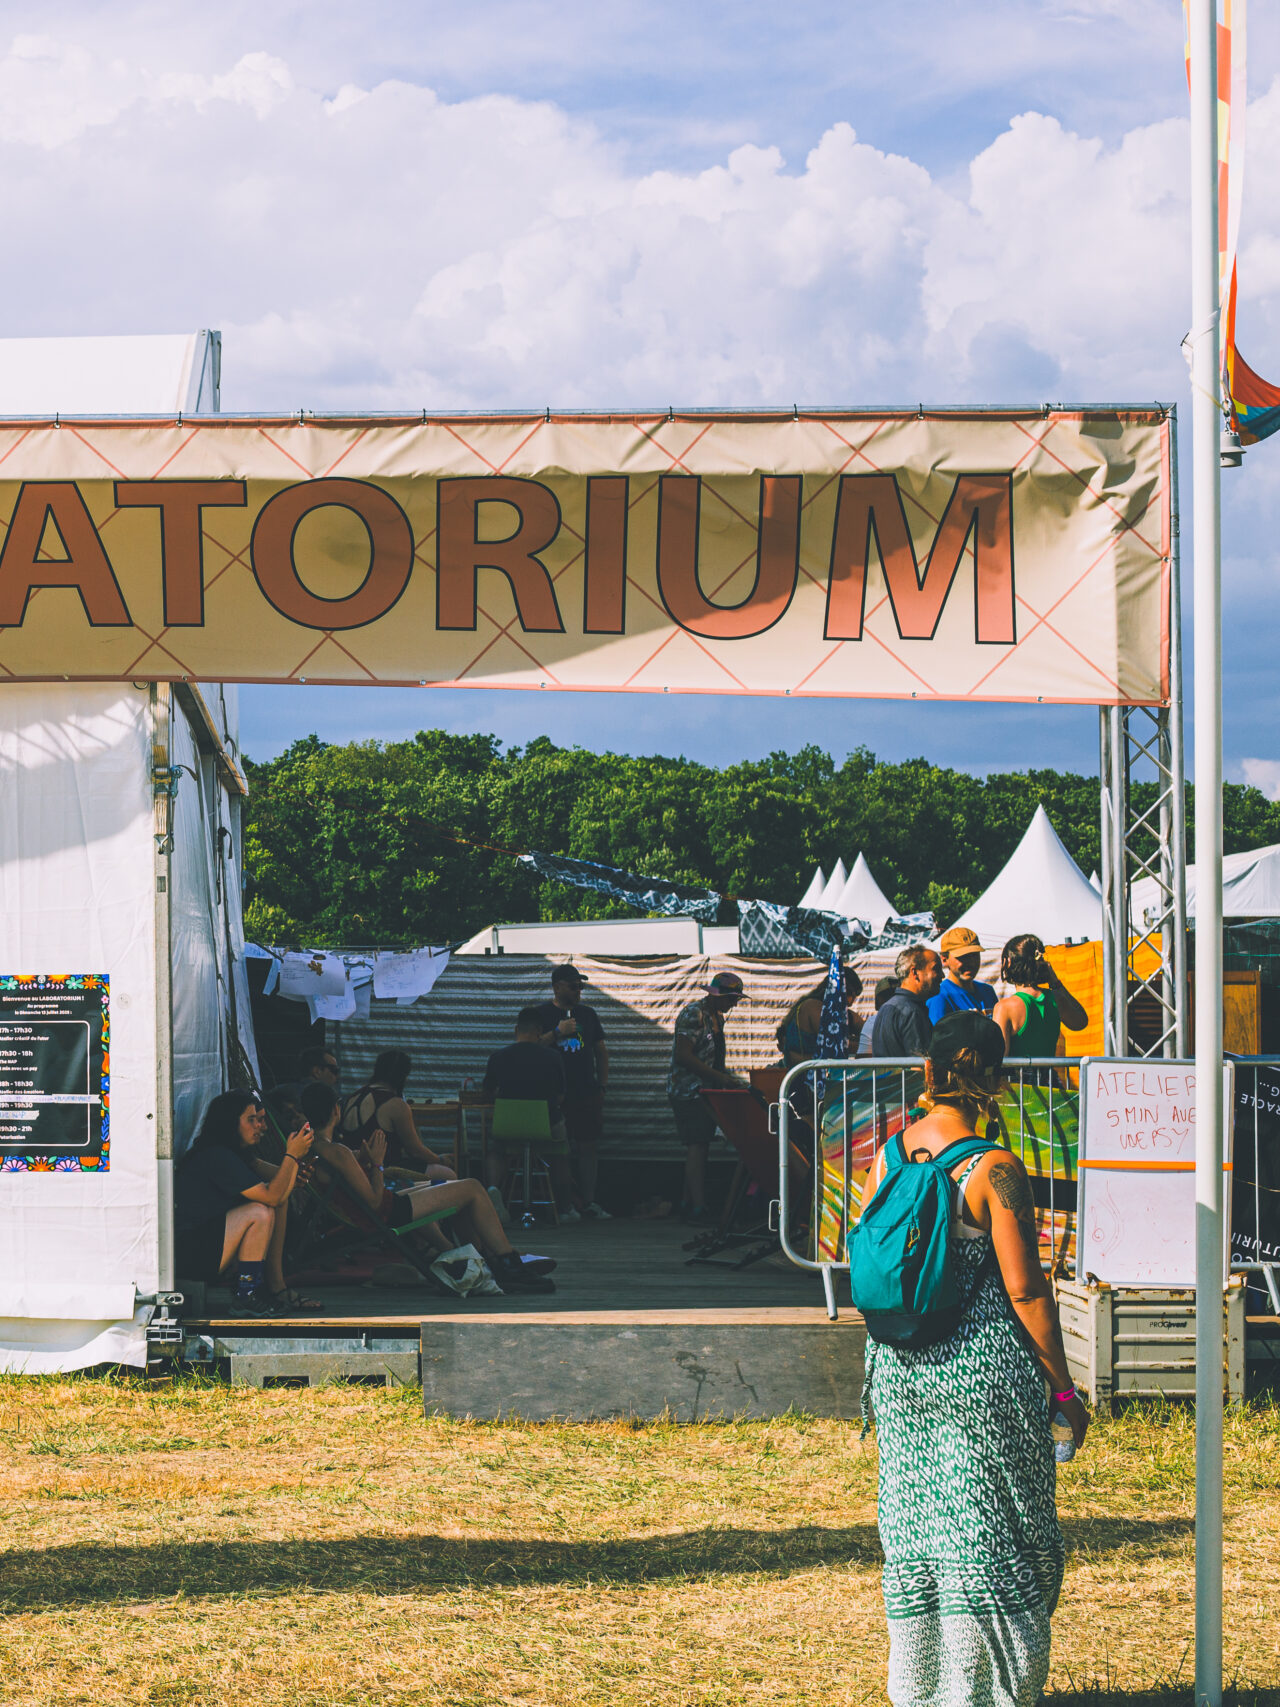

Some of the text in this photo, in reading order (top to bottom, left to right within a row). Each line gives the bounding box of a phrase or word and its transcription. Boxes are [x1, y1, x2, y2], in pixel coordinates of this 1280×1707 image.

[1107, 1109, 1120, 1128] 5
[1124, 1104, 1159, 1126] MIN
[1152, 1127, 1189, 1154] PSY
